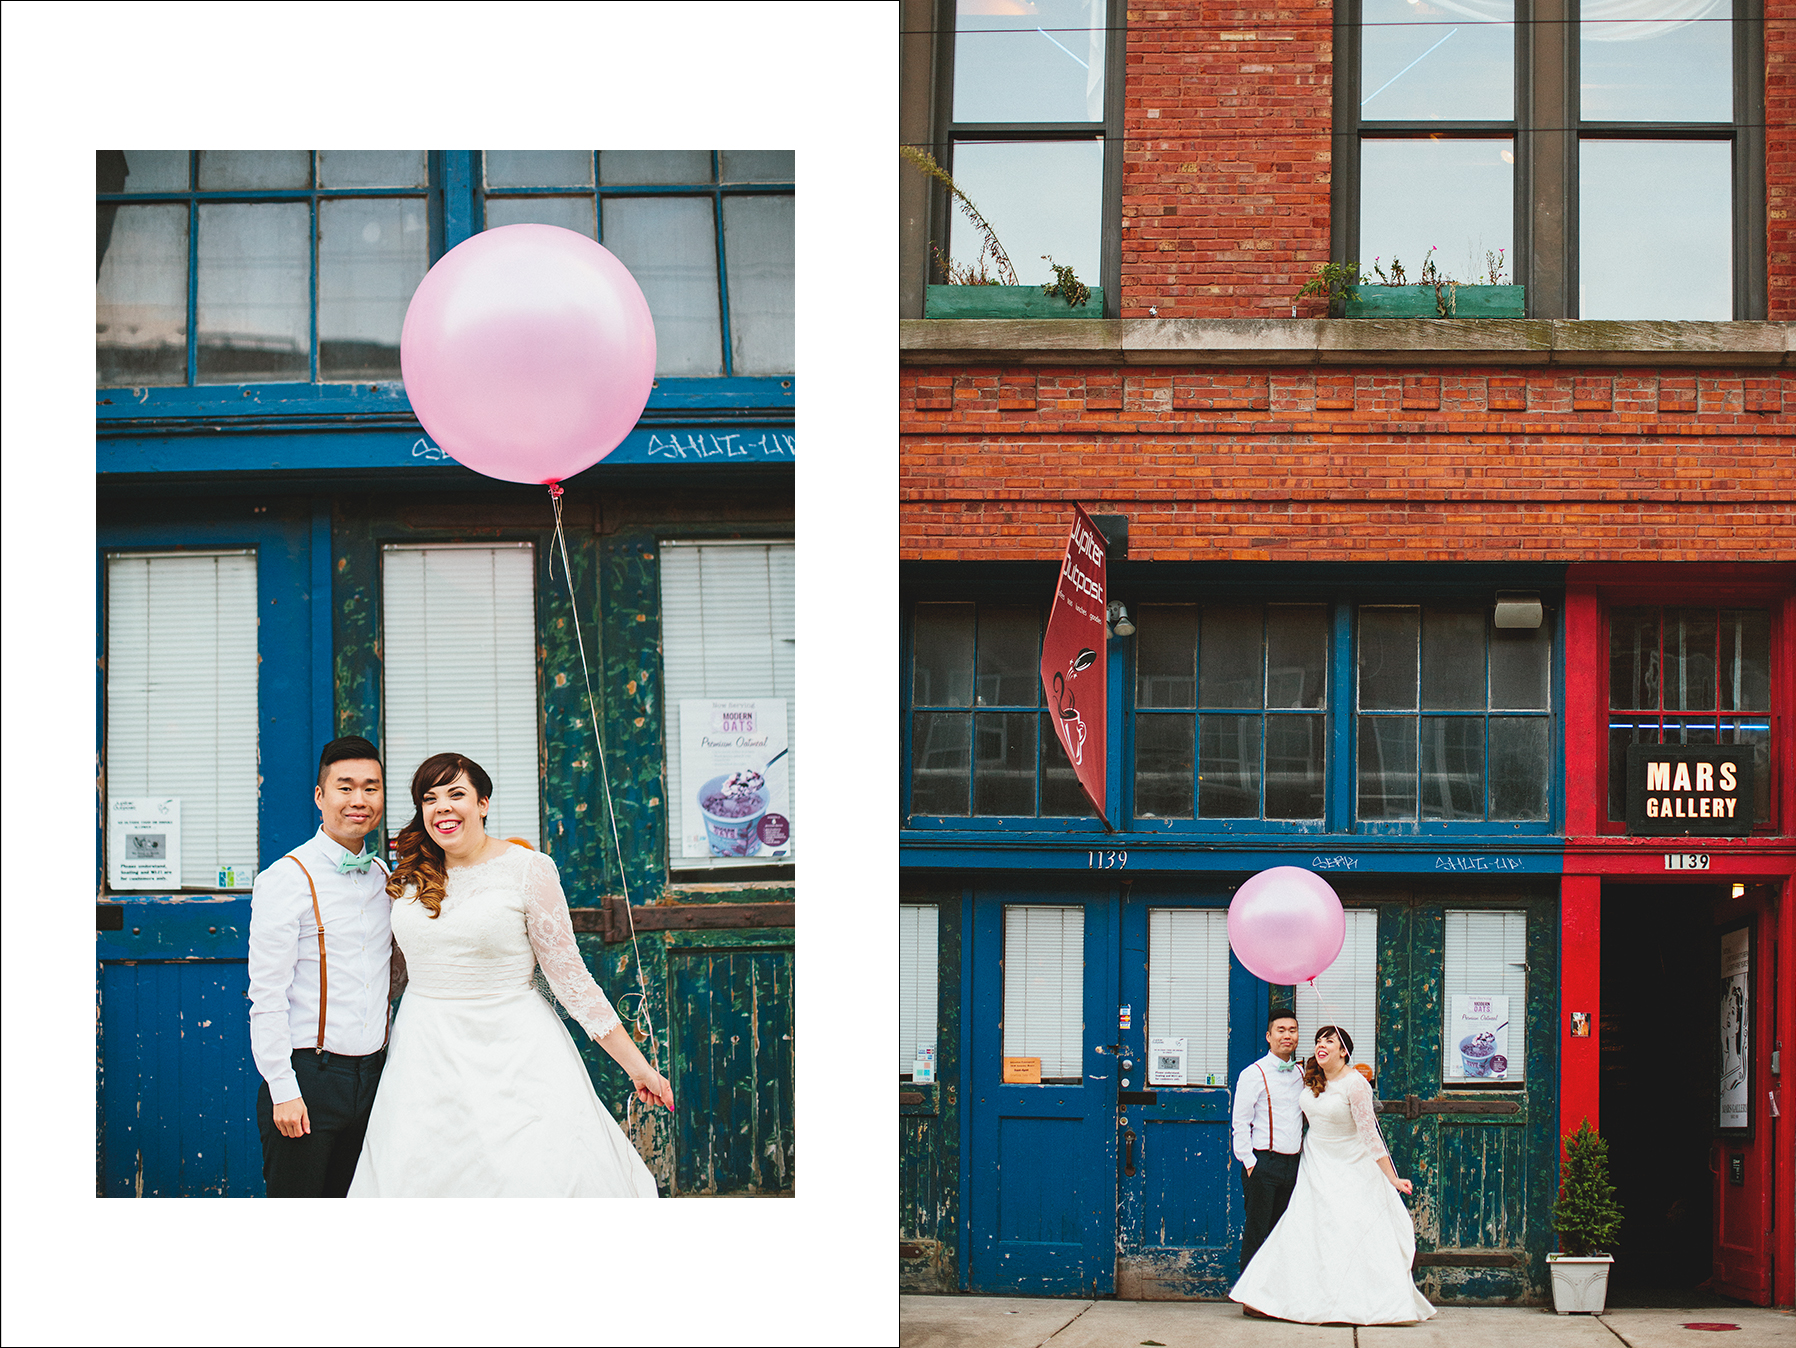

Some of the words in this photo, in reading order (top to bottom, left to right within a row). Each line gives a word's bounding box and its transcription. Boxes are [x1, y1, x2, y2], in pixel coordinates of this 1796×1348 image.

[1071, 516, 1104, 568] Jupiter
[723, 712, 752, 720] MODERN
[723, 721, 753, 732] OATS
[701, 736, 732, 747] Premium
[736, 736, 768, 747] Oatmeal
[1646, 762, 1737, 791] MARS
[1646, 797, 1737, 818] GALLERY
[1088, 850, 1127, 870] 1139
[1668, 854, 1709, 868] 1139
